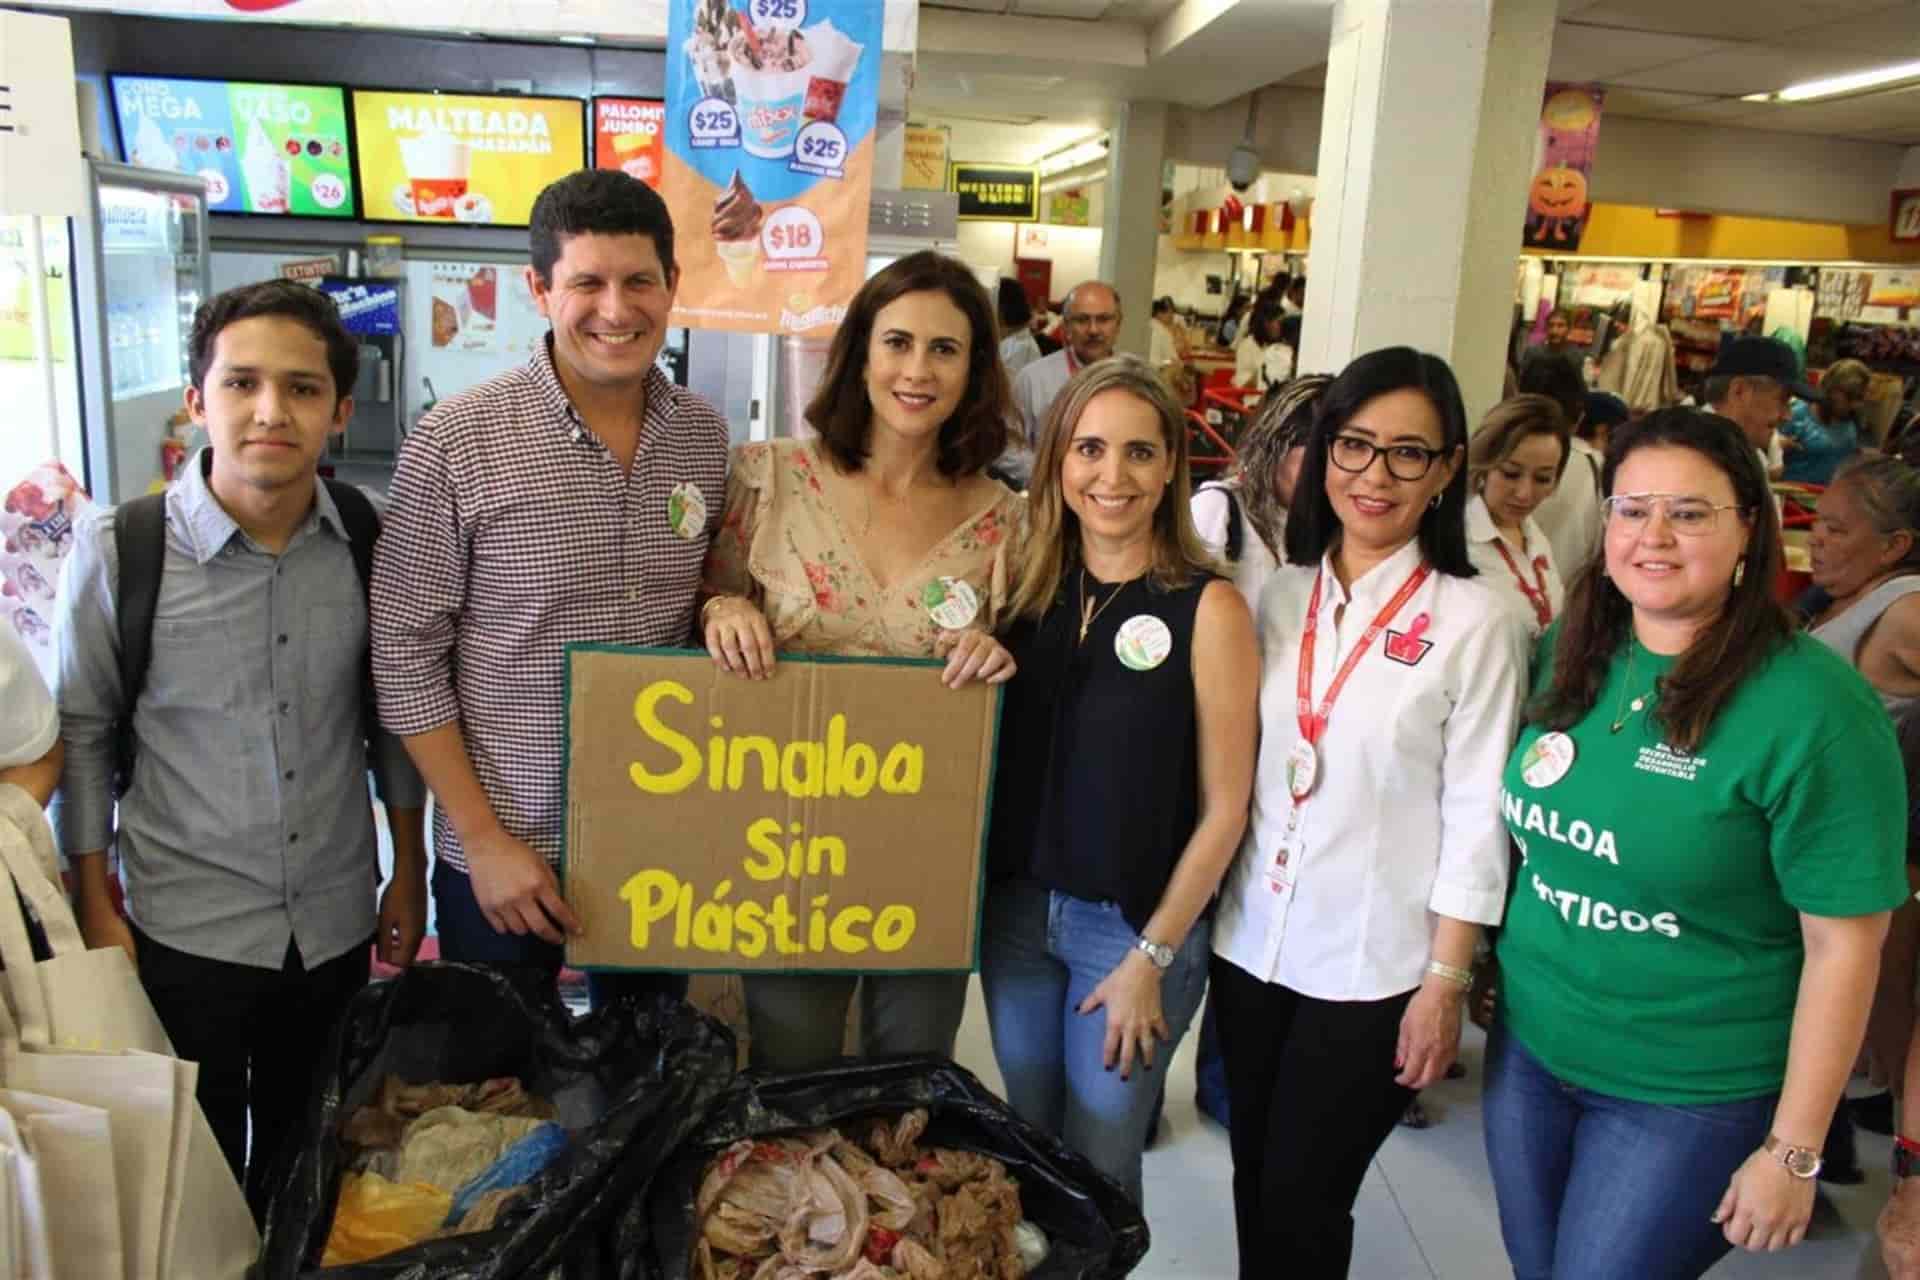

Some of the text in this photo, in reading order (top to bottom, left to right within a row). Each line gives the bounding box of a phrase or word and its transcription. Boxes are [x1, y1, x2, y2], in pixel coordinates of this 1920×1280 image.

[756, 0, 797, 18] $25
[121, 96, 202, 120] MEGA
[386, 106, 551, 136] MALTEADA
[600, 119, 658, 135] JUMBO
[695, 111, 733, 130] $25
[803, 136, 841, 158] $25
[958, 182, 1026, 194] WESTERN
[977, 192, 1026, 204] UNION
[769, 223, 812, 249] $18
[629, 679, 924, 799] Sinaloa
